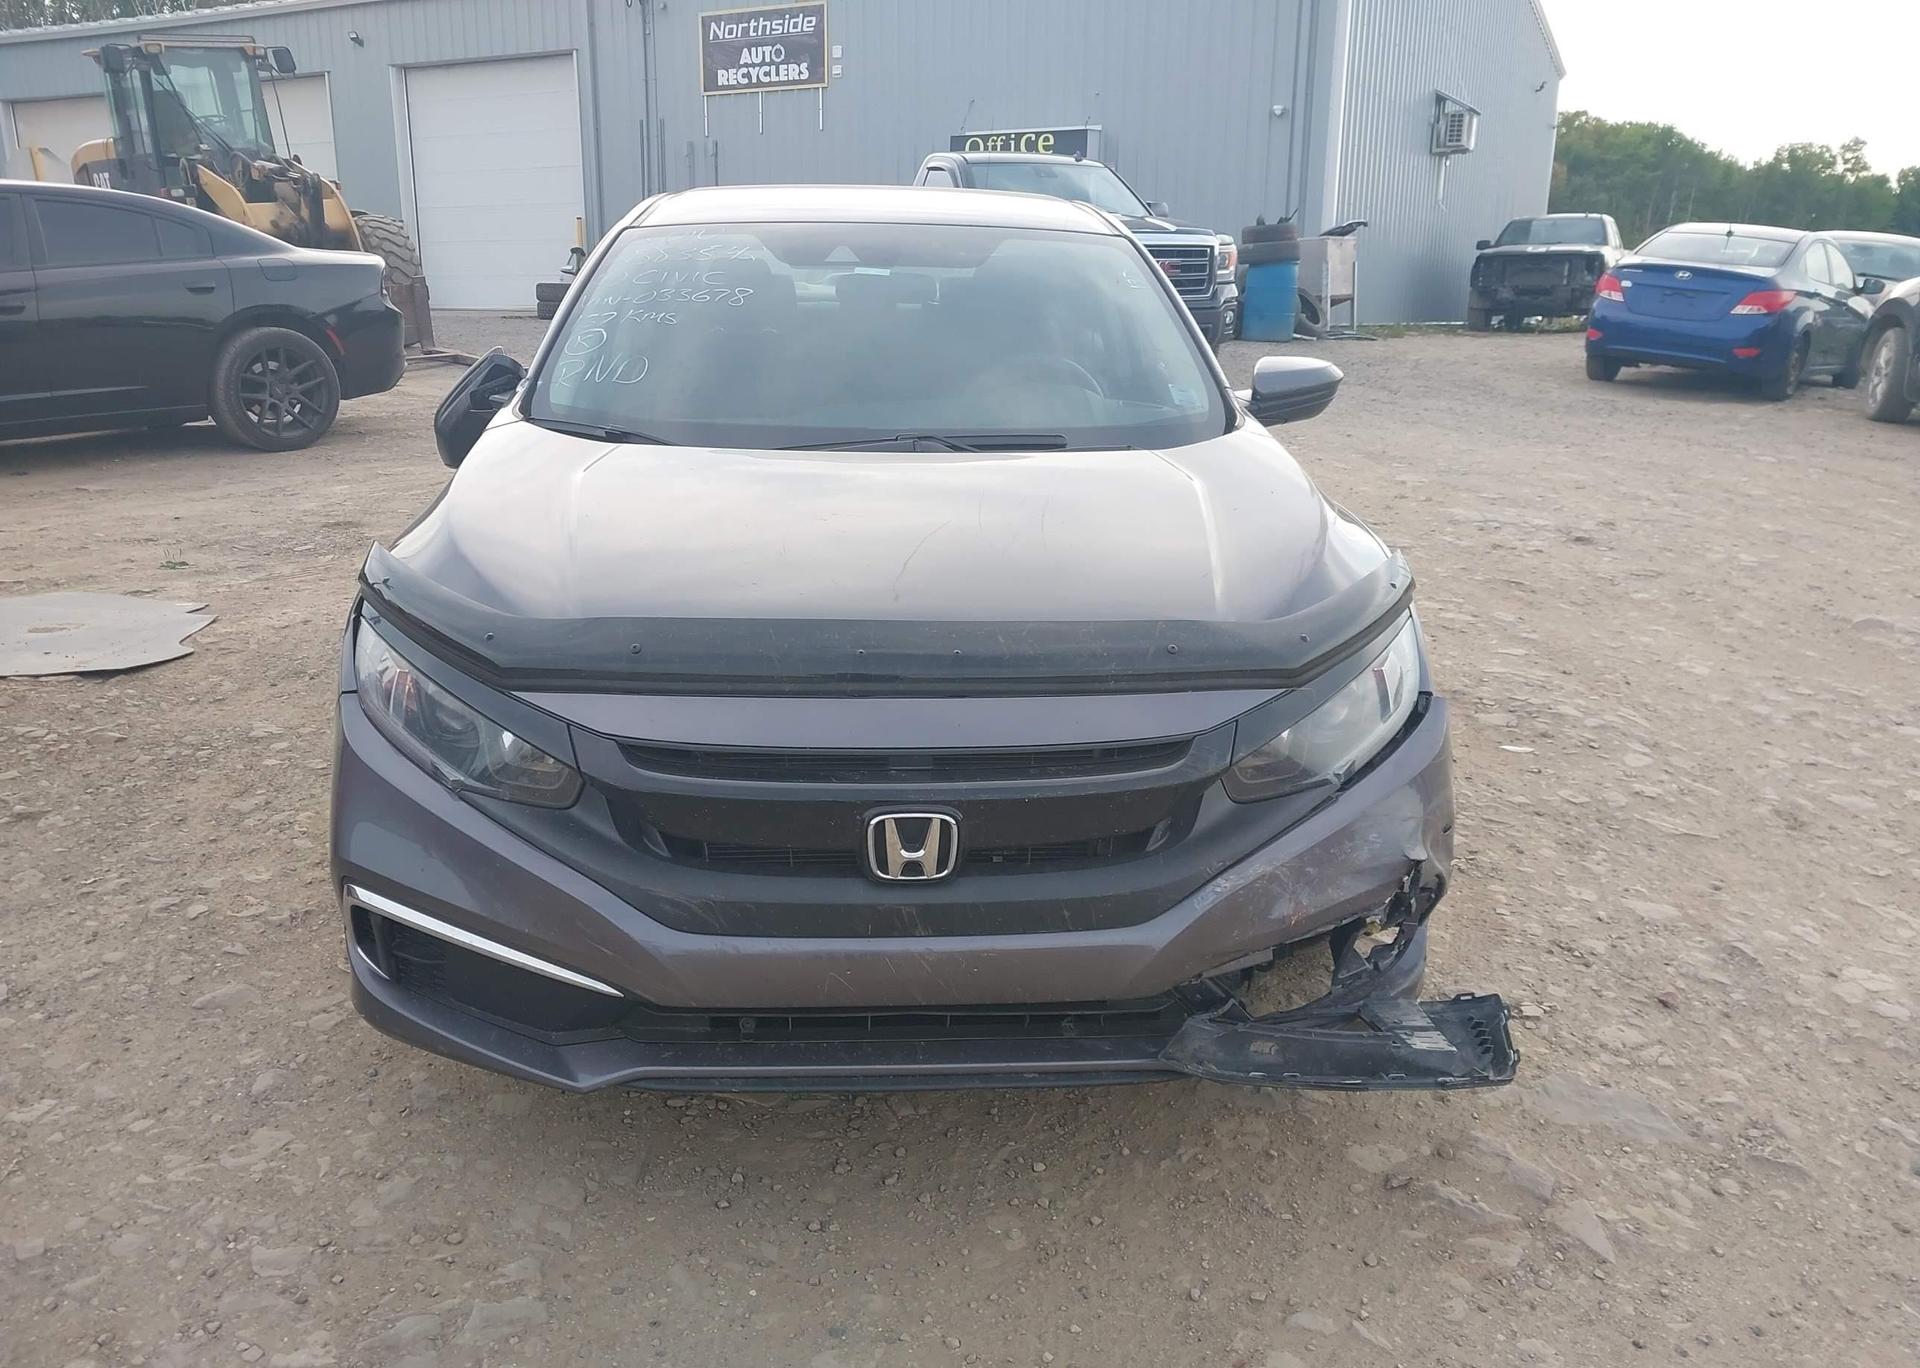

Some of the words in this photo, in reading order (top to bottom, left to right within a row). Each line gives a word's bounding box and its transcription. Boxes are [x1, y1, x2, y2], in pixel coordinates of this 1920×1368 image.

[709, 13, 817, 40] Northside
[739, 44, 785, 65] AUTO
[717, 62, 810, 86] RECYCLERS
[964, 132, 1054, 154] Office
[92, 172, 111, 190] CAT
[632, 270, 725, 285] CIVIC
[558, 352, 649, 387] RND
